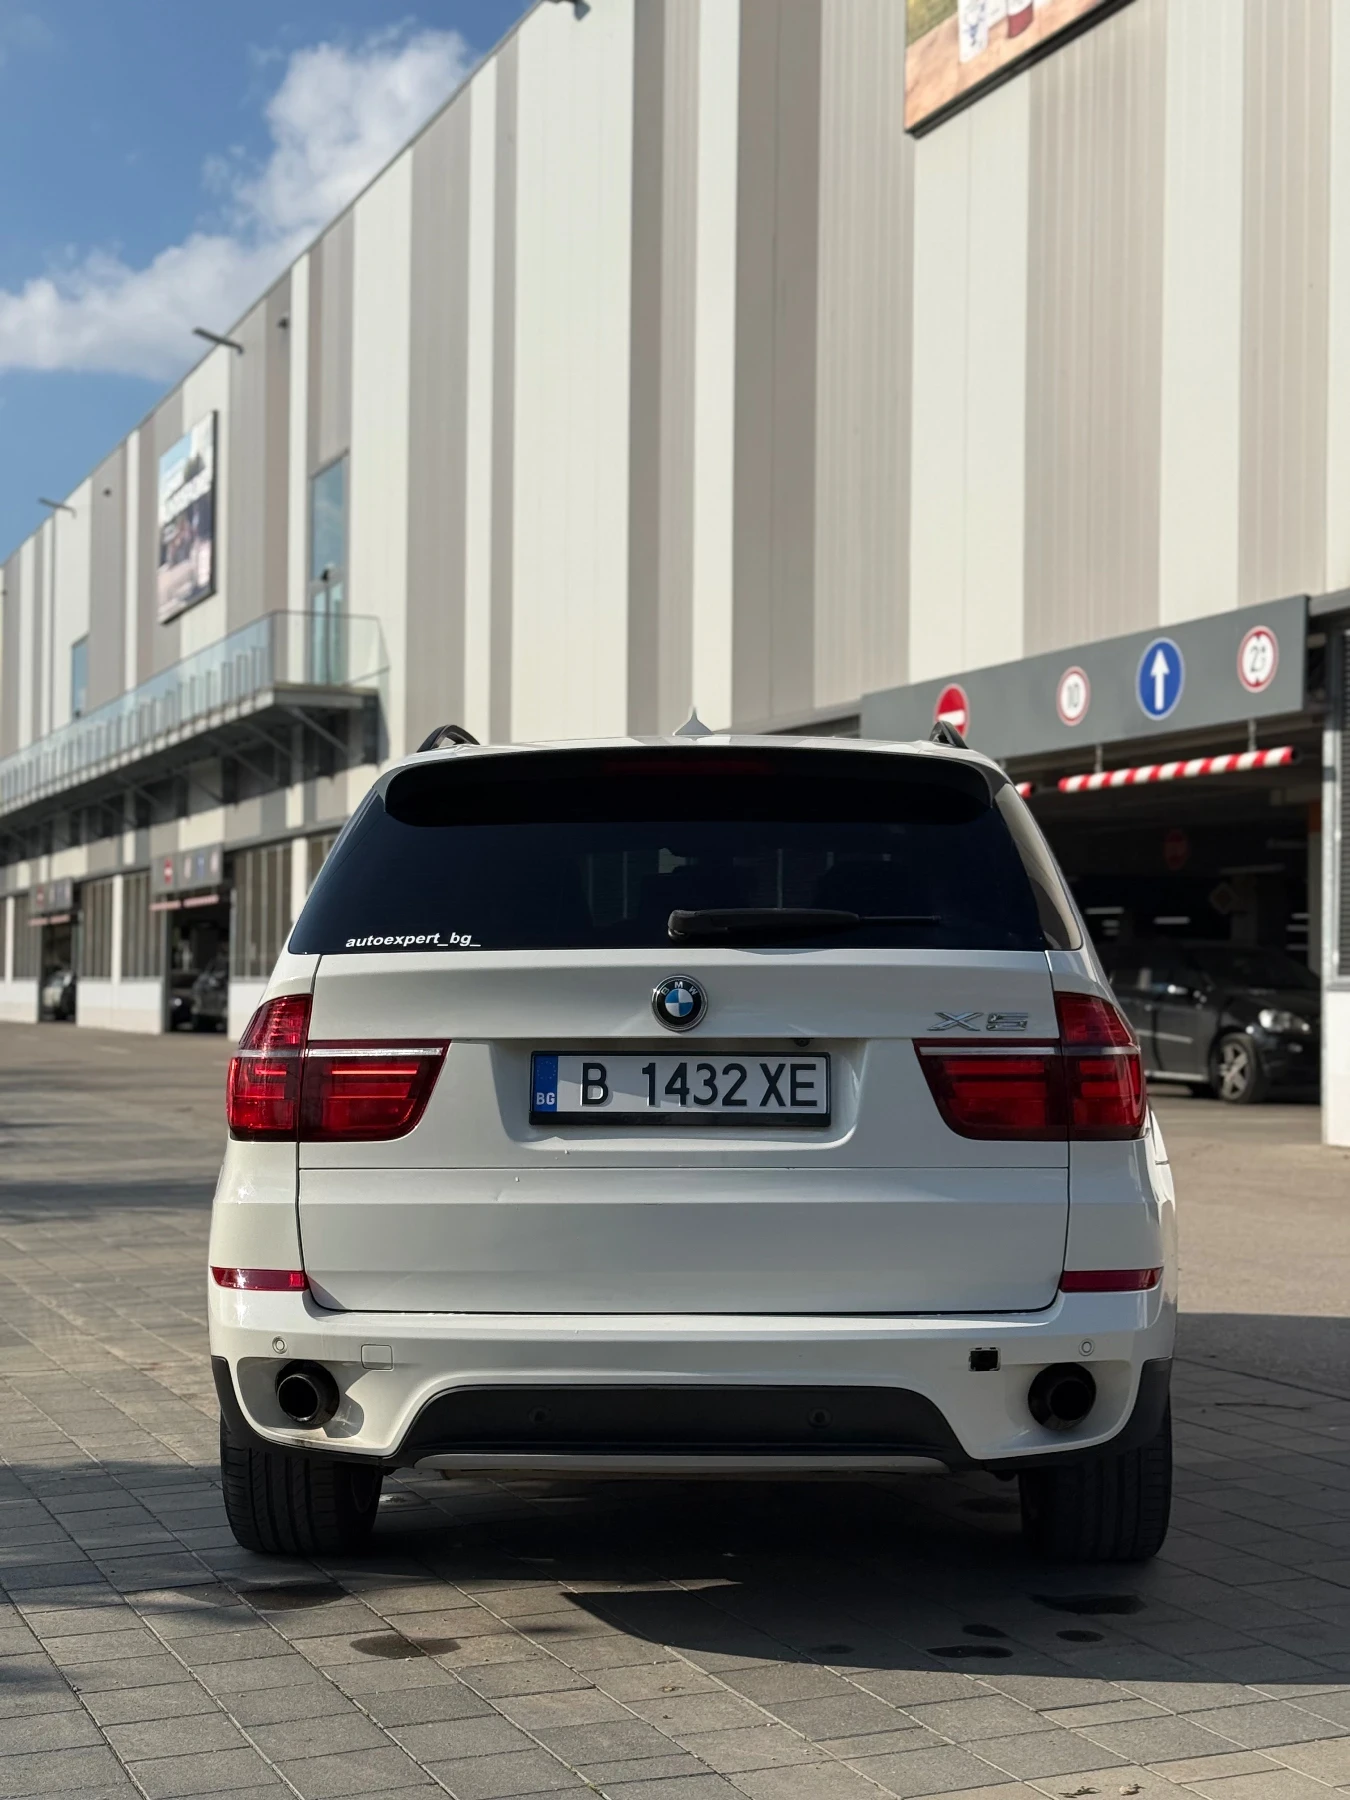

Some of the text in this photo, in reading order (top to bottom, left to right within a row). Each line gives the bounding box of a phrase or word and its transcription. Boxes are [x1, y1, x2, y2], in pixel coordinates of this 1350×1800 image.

[345, 932, 481, 948] autoexpert_bg_
[661, 981, 698, 996] BMW
[926, 1012, 1029, 1031] X5
[580, 1063, 817, 1107] B 1432 XE
[536, 1092, 555, 1105] BG
